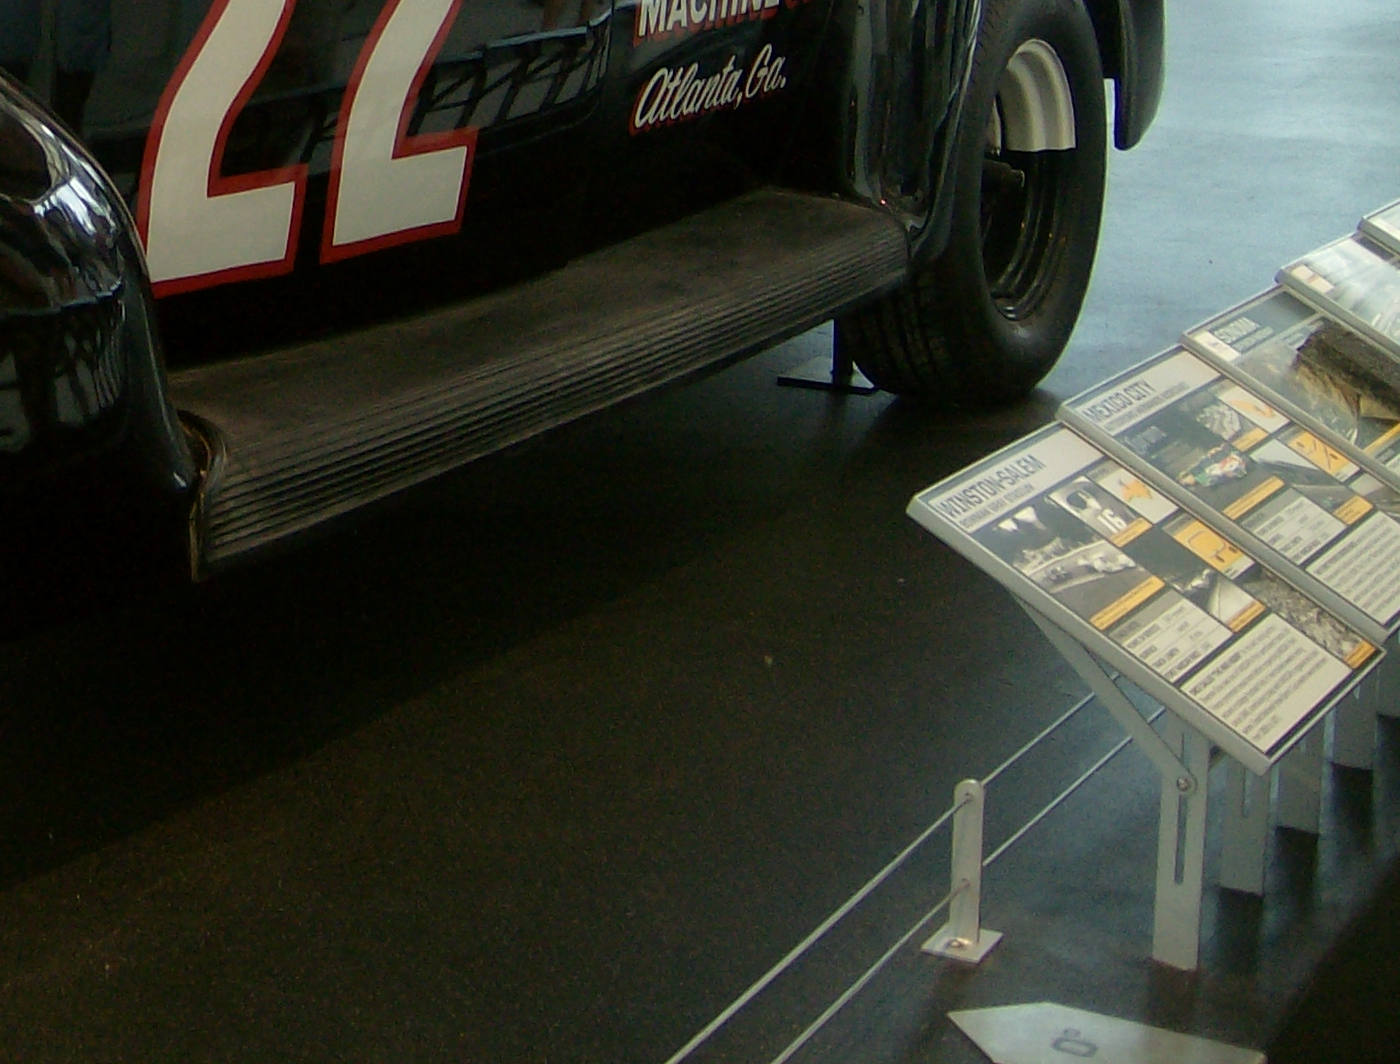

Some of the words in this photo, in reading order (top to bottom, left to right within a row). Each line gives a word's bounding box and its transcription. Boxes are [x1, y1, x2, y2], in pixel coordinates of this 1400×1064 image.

[1081, 391, 1134, 423] MEXICO
[1123, 379, 1157, 402] CITY
[936, 453, 1047, 519] WINSTON-SALEM
